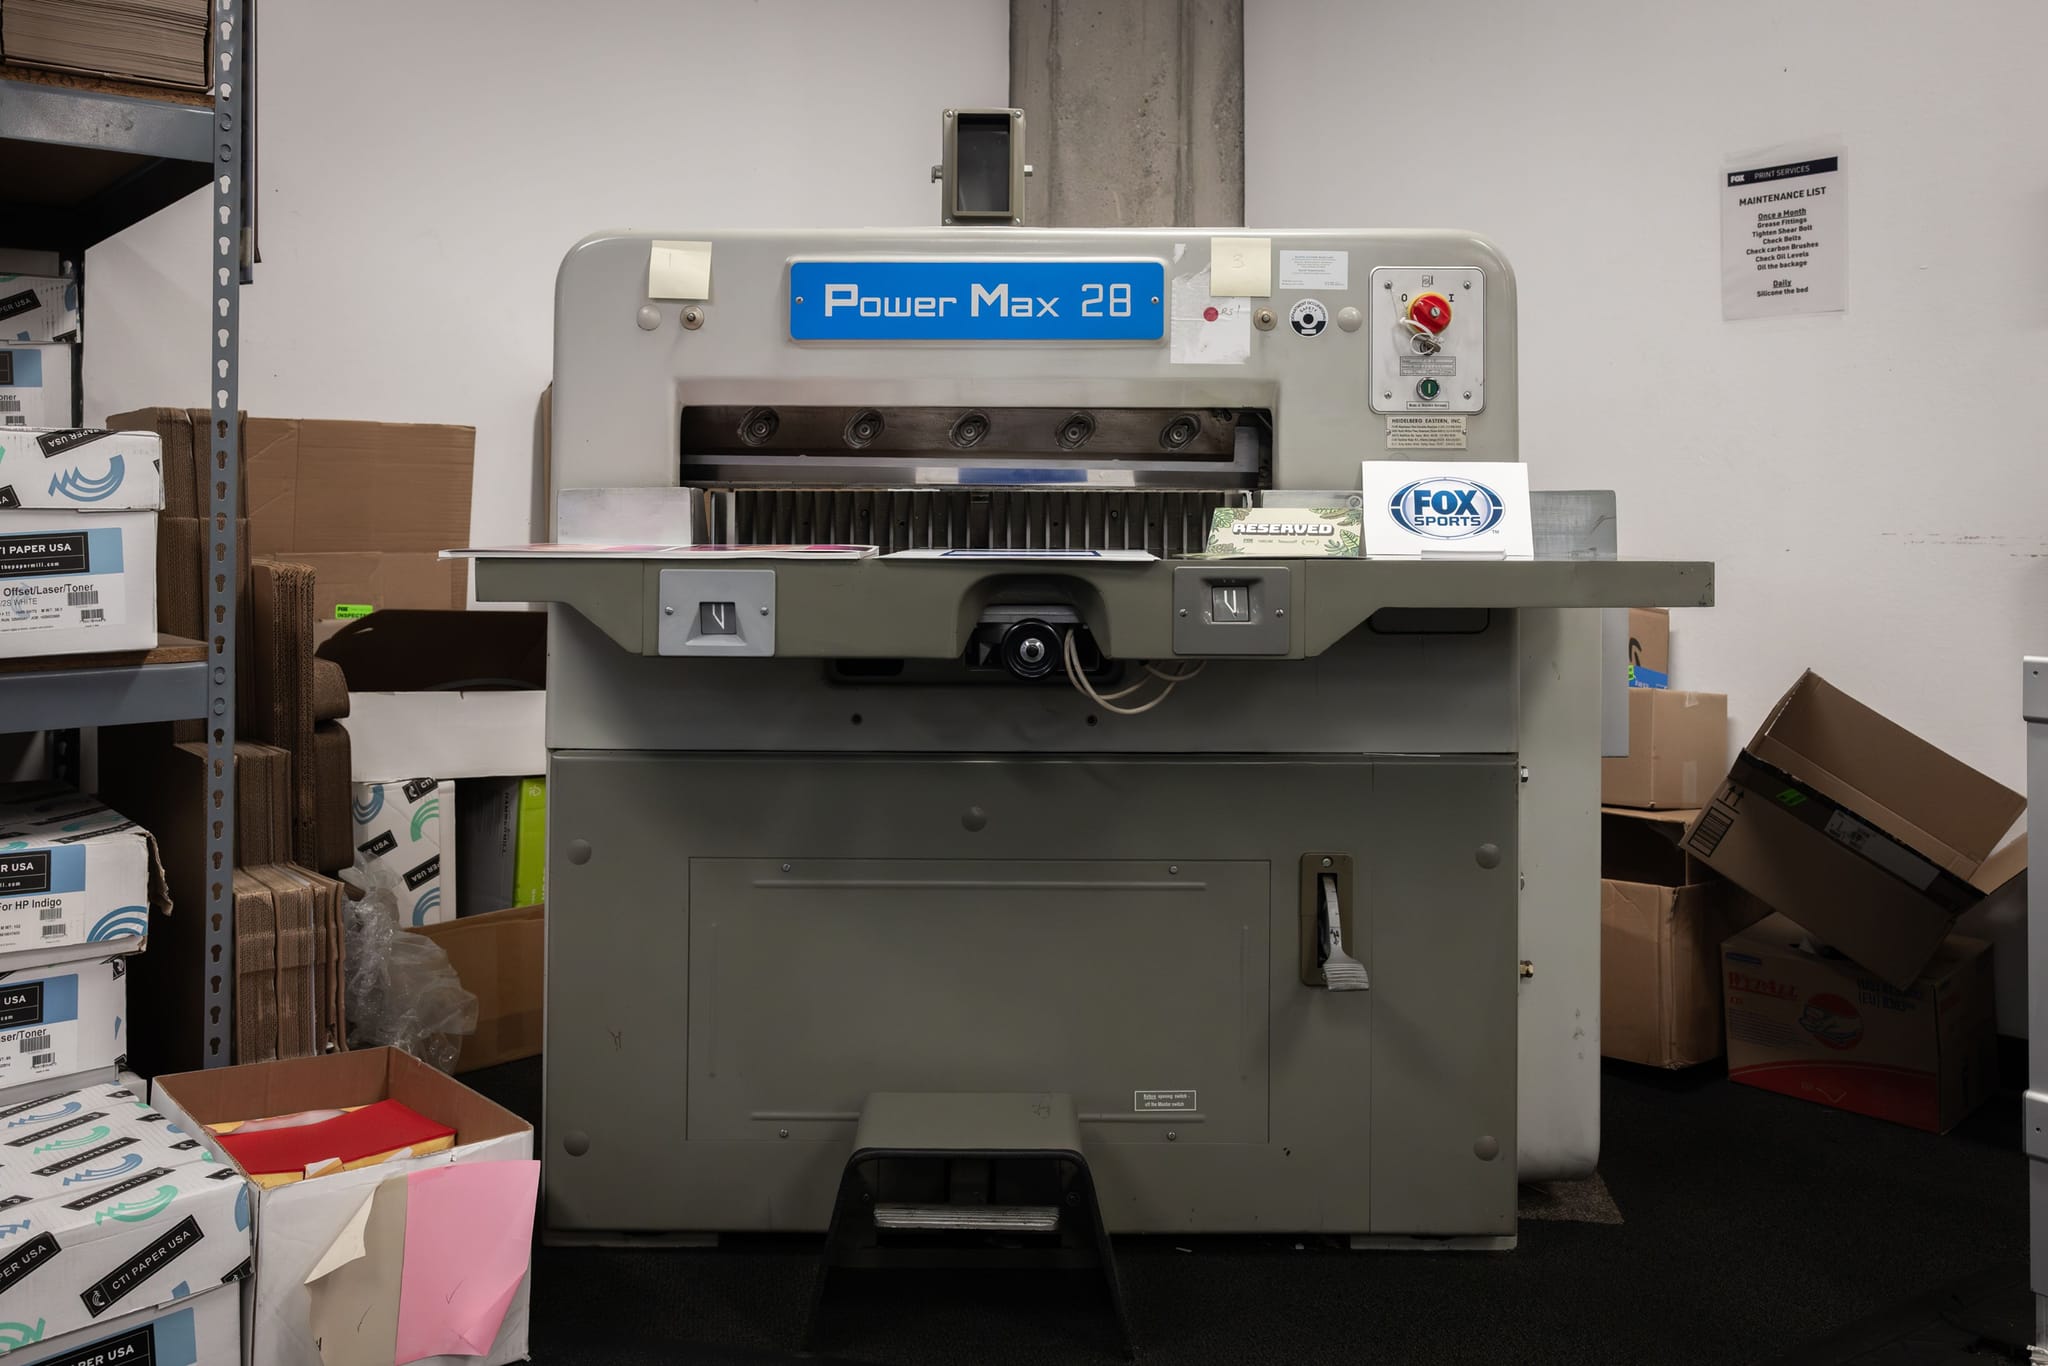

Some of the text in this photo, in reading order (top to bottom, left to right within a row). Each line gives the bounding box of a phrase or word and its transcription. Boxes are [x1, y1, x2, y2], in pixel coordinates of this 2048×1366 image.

[1730, 165, 1810, 184] FOX PRINT SERVICES
[1739, 186, 1826, 206] MAINTENANCE LIST
[1758, 212, 1776, 221] Once
[1784, 208, 1807, 218] Month
[1757, 217, 1808, 229] Grease Fittings
[1752, 230, 1777, 238] Tighten
[1778, 226, 1798, 235] Shear
[1762, 234, 1802, 245] Check Belts
[1746, 242, 1819, 256] Check carbon Brushes
[1755, 251, 1809, 262] Check Oil Levels
[1757, 263, 1766, 271] Oil
[1773, 280, 1792, 289] Daily
[1757, 290, 1782, 298] Silicone
[14, 298, 32, 308] USA
[824, 283, 1132, 318] Power Max 28
[48, 436, 68, 447] USA
[1413, 489, 1480, 516] FOX
[1414, 515, 1481, 527] SPORTS
[1232, 522, 1334, 536] RESERVED
[10, 544, 46, 554] PAPER
[49, 543, 72, 552] USA
[4, 584, 94, 596] Offset/Laser/Toner
[14, 598, 38, 606] WHITE
[373, 840, 390, 851] USA
[12, 862, 34, 872] USA
[411, 871, 428, 882] USA
[16, 900, 29, 910] HP
[32, 898, 62, 908] Indigo
[4, 994, 26, 1005] USA
[21, 1245, 47, 1264] USA
[112, 1231, 191, 1290] CTI PAPER USA
[108, 1344, 134, 1360] USA
